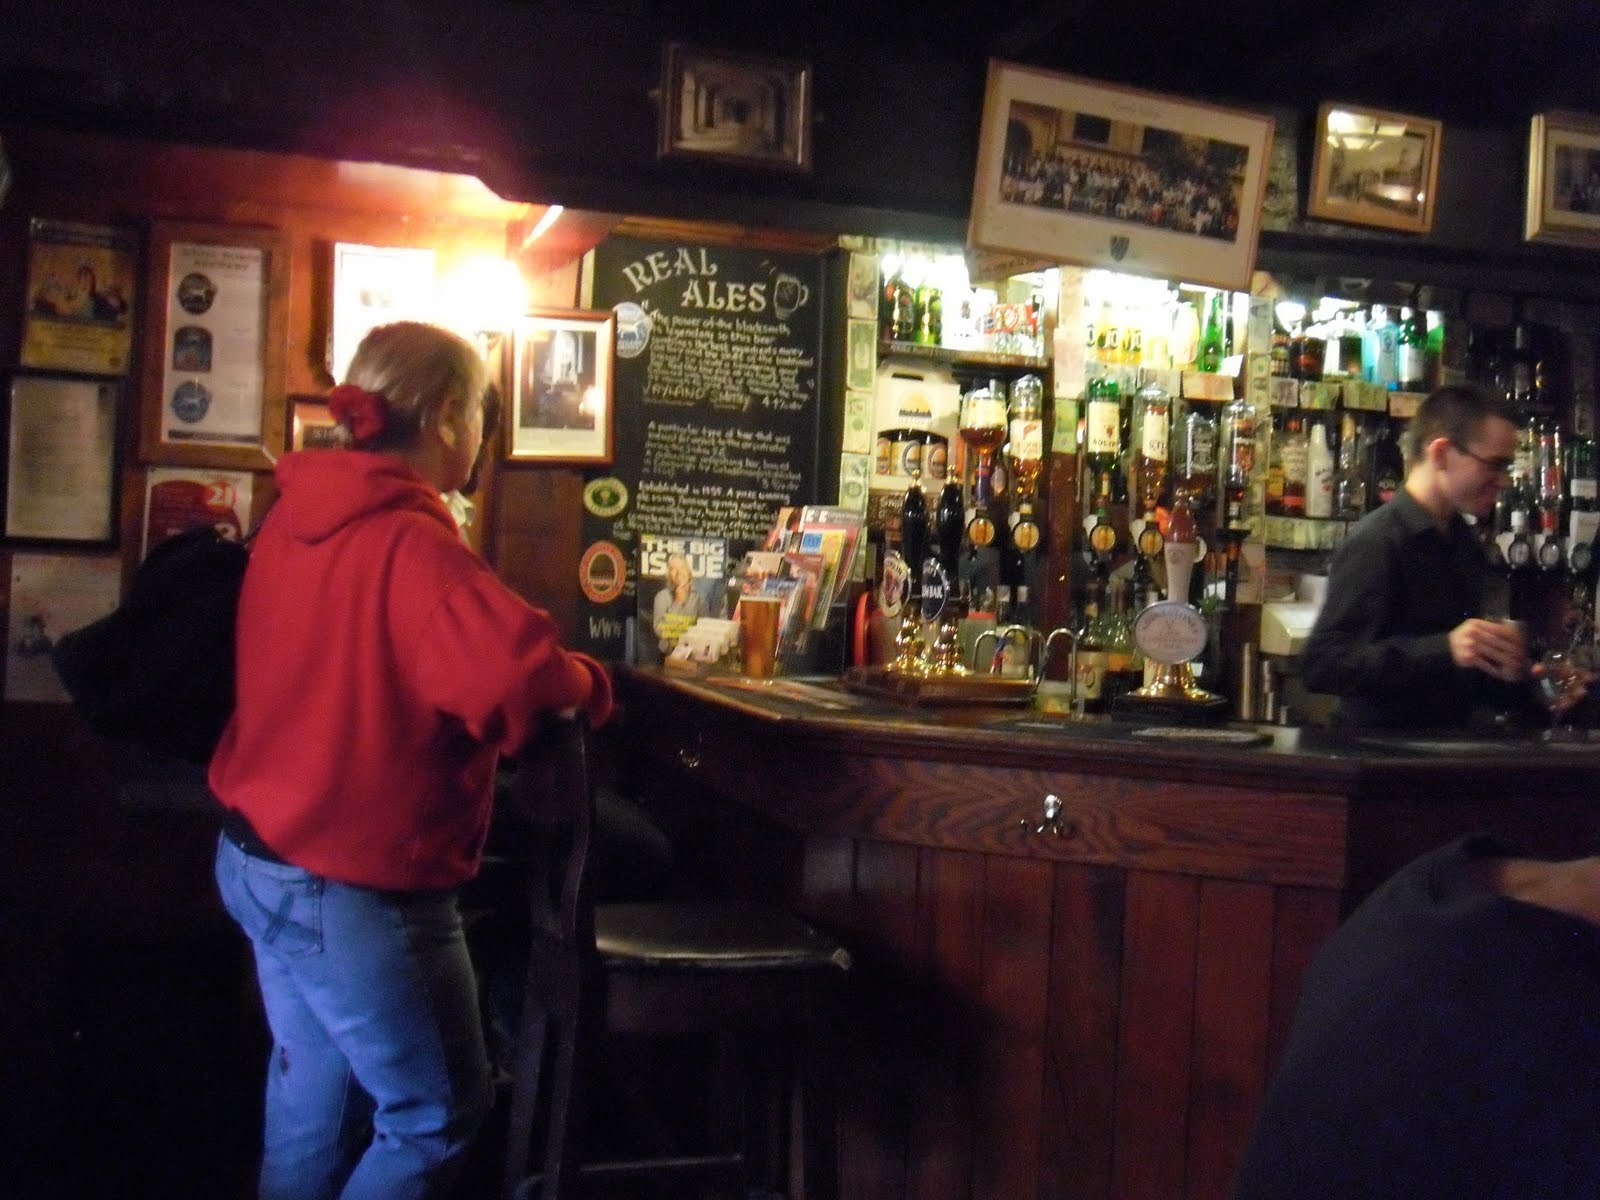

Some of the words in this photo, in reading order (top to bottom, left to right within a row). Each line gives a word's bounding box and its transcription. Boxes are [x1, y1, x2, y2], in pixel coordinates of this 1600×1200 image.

[622, 248, 718, 293] REAL
[680, 278, 767, 313] ALES
[641, 537, 686, 554] THE
[689, 540, 724, 556] BIG
[640, 552, 723, 579] ISUE
